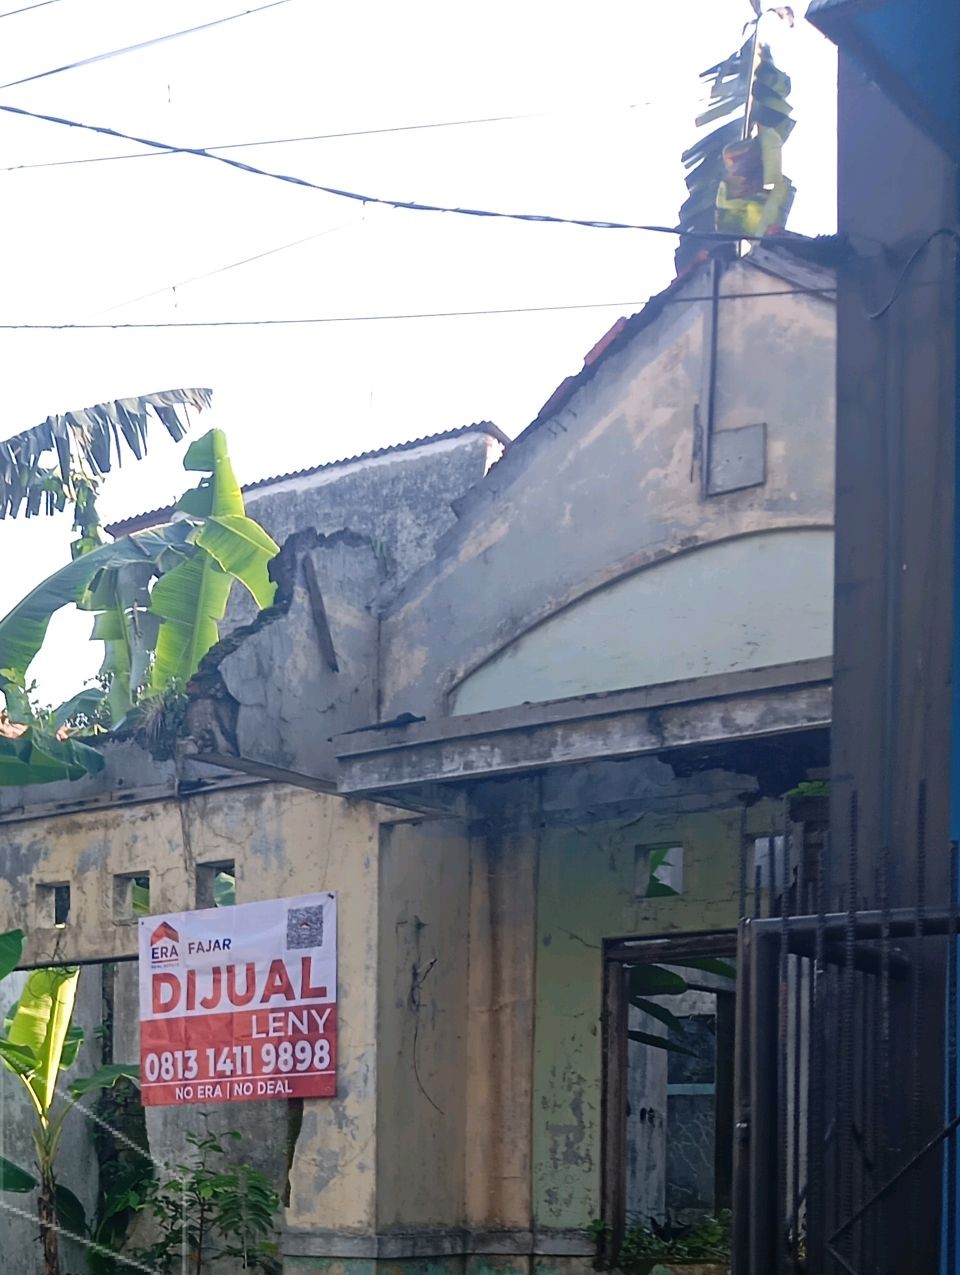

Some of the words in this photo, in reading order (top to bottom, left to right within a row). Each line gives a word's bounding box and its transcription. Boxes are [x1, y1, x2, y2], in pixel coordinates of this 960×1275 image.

[152, 945, 179, 960] ERA
[188, 938, 232, 954] FAJAR
[152, 956, 327, 1014] DIJUAL
[251, 1008, 332, 1039] LENY
[145, 1049, 198, 1082] 0813
[206, 1045, 253, 1077] 1411
[261, 1039, 330, 1074] 9898
[175, 1087, 193, 1100] NO
[197, 1085, 222, 1098] ERA
[234, 1082, 253, 1096] NO
[257, 1080, 293, 1095] DEAL
